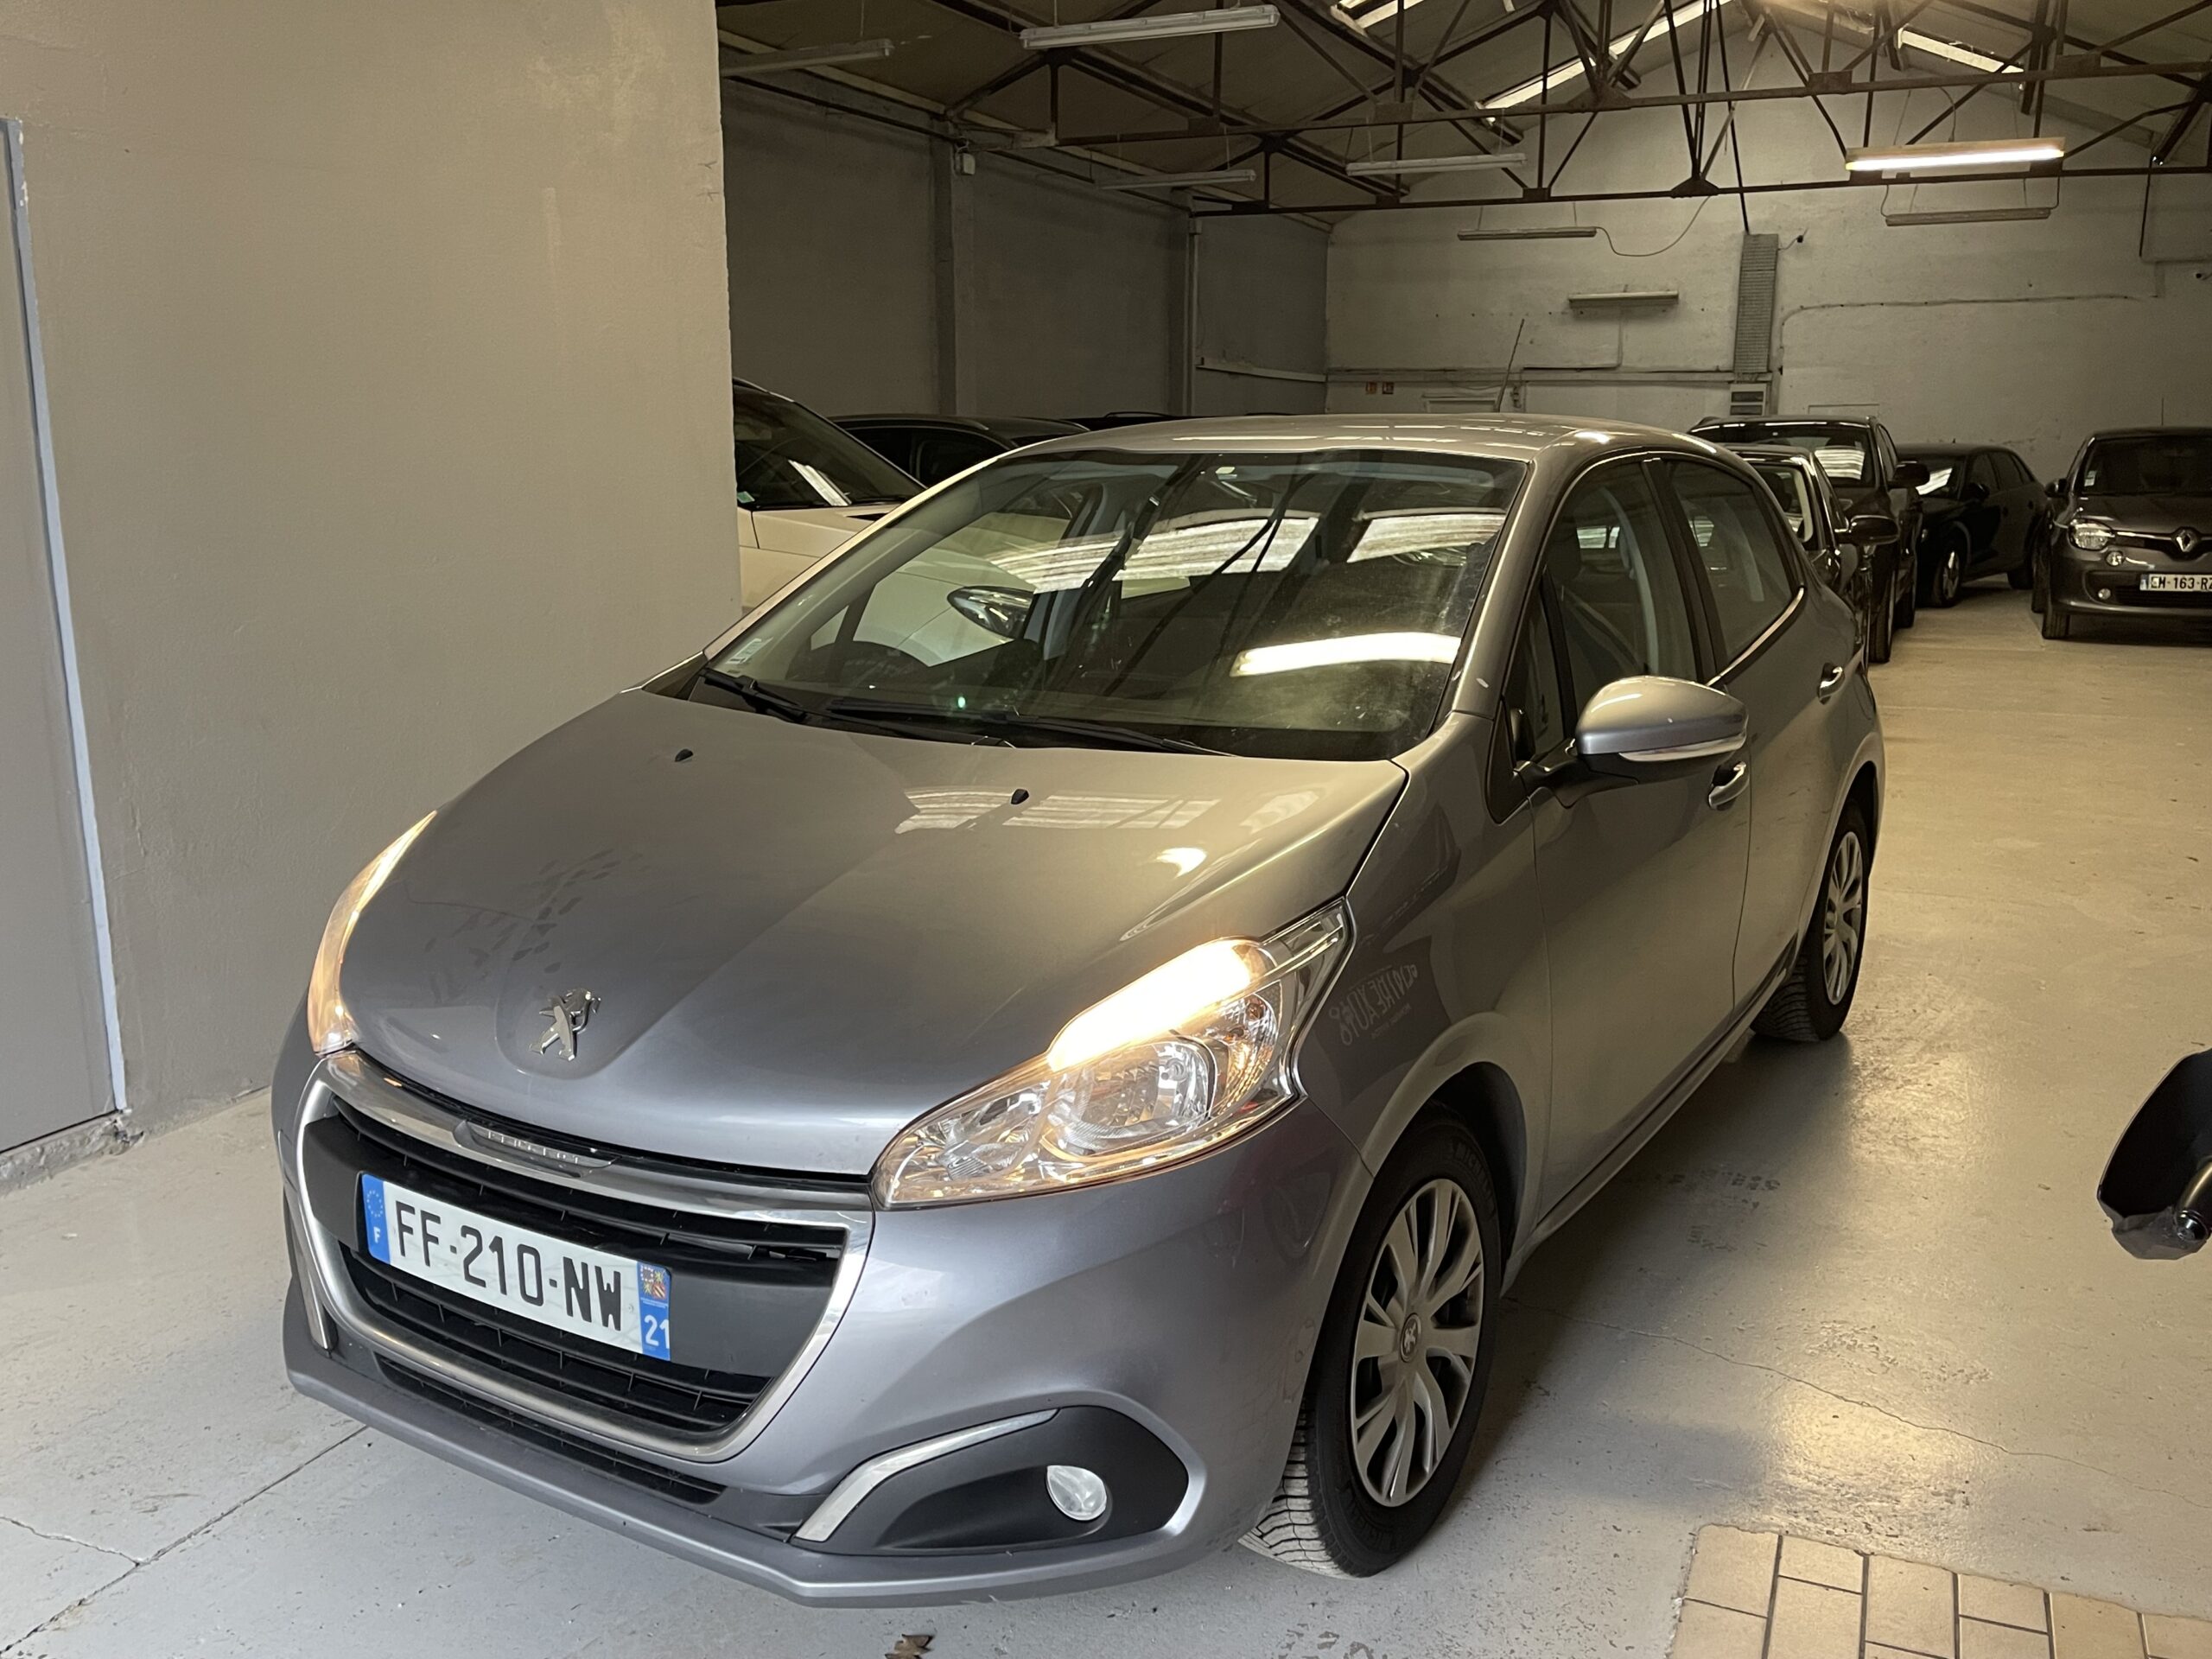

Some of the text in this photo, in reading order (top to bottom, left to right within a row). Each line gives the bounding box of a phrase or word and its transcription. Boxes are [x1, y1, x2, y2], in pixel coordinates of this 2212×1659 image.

[373, 1226, 381, 1243] F
[395, 1200, 621, 1332] FF-210-NW
[645, 1314, 670, 1349] 21
